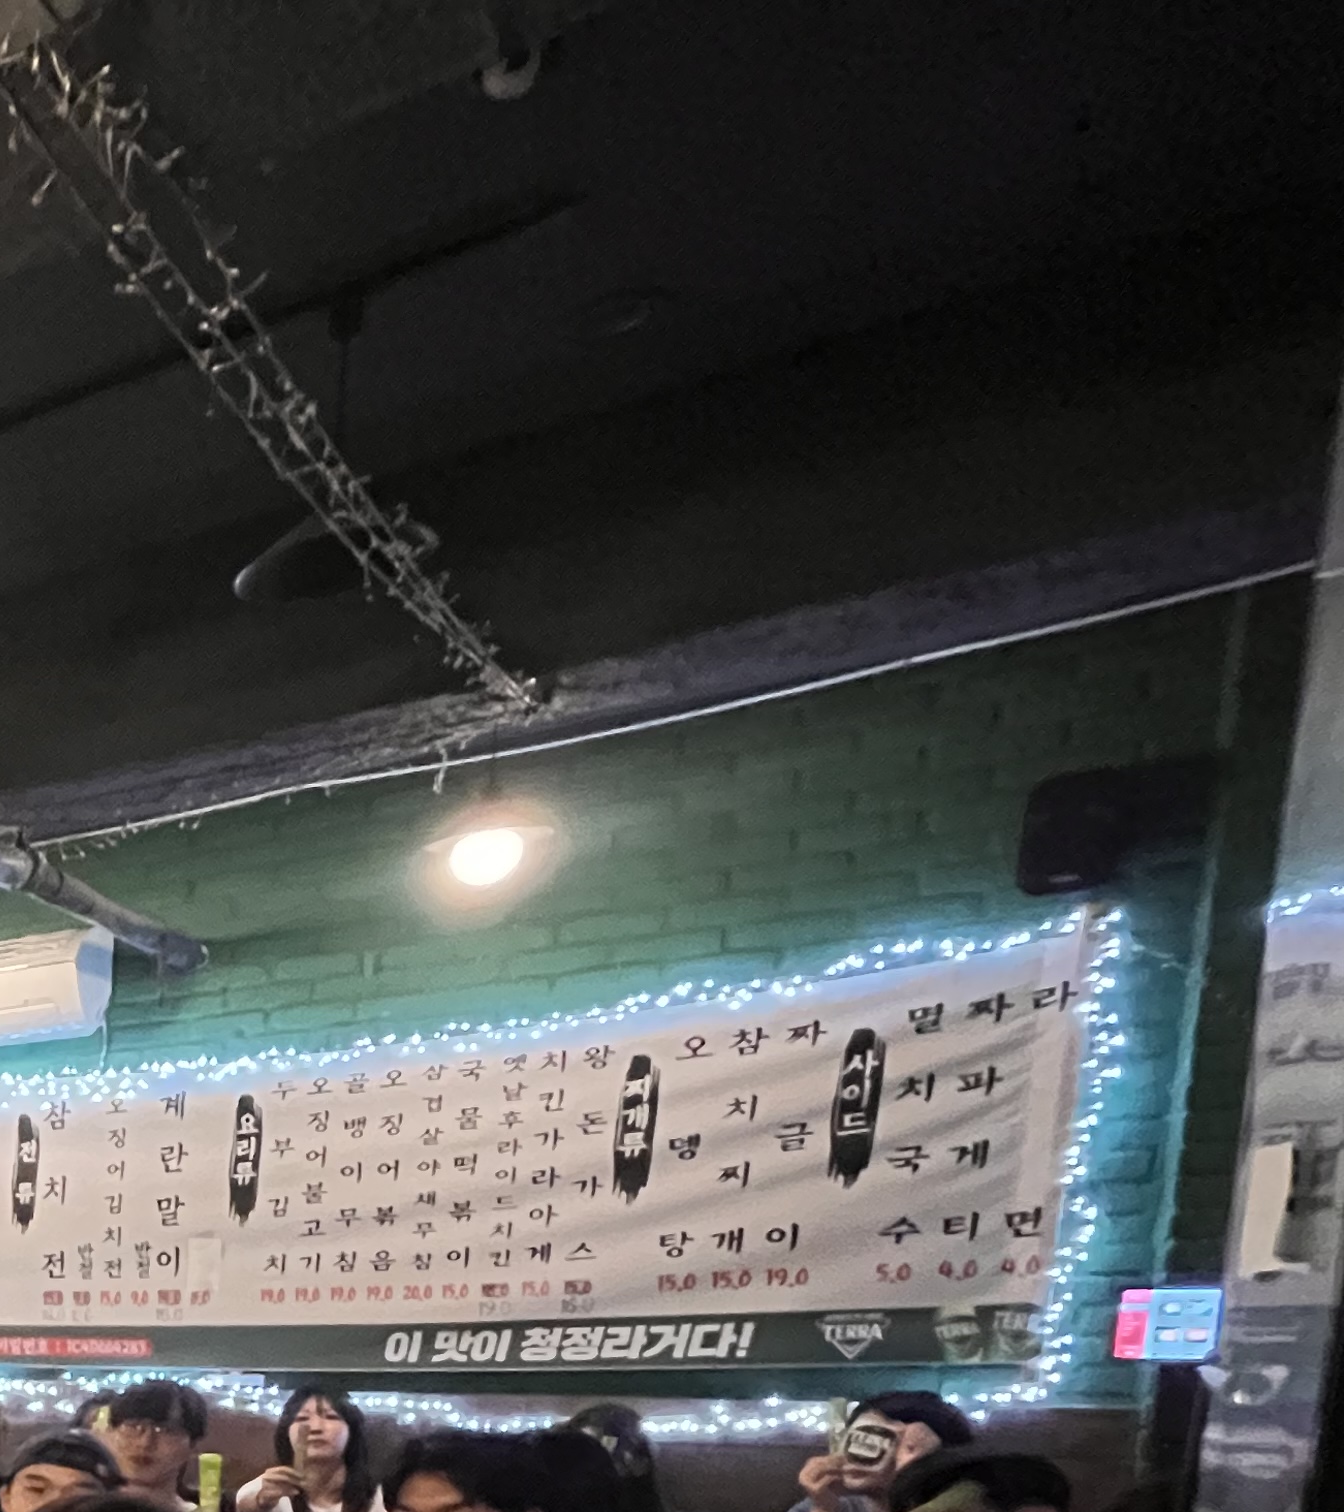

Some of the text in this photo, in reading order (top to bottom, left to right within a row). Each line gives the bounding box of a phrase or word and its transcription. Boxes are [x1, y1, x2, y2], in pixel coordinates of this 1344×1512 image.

[616, 1073, 652, 1159] 찌개류
[836, 1049, 880, 1137] 사이드
[15, 1139, 37, 1206] 전류
[102, 1098, 128, 1281] 오징어김치전
[156, 1090, 189, 1278] 계란말이
[232, 1112, 260, 1186] 요리류
[263, 1079, 298, 1275] 두부김치
[298, 1076, 334, 1275] 오징어불고기
[333, 1072, 370, 1273] 골뱅이무침
[369, 1069, 408, 1272] 오징어볶음
[446, 1059, 487, 1269] 국물떡볶이
[564, 1044, 616, 1262] 왕돈가스
[403, 1284, 434, 1301] 20.0
[657, 1266, 809, 1292] 15.0 15.0 19.0
[875, 1254, 1041, 1284] 5.0 4.0 4.0
[384, 1321, 754, 1363] 이 맛이 청정라거다!
[824, 1322, 883, 1342] TERRA
